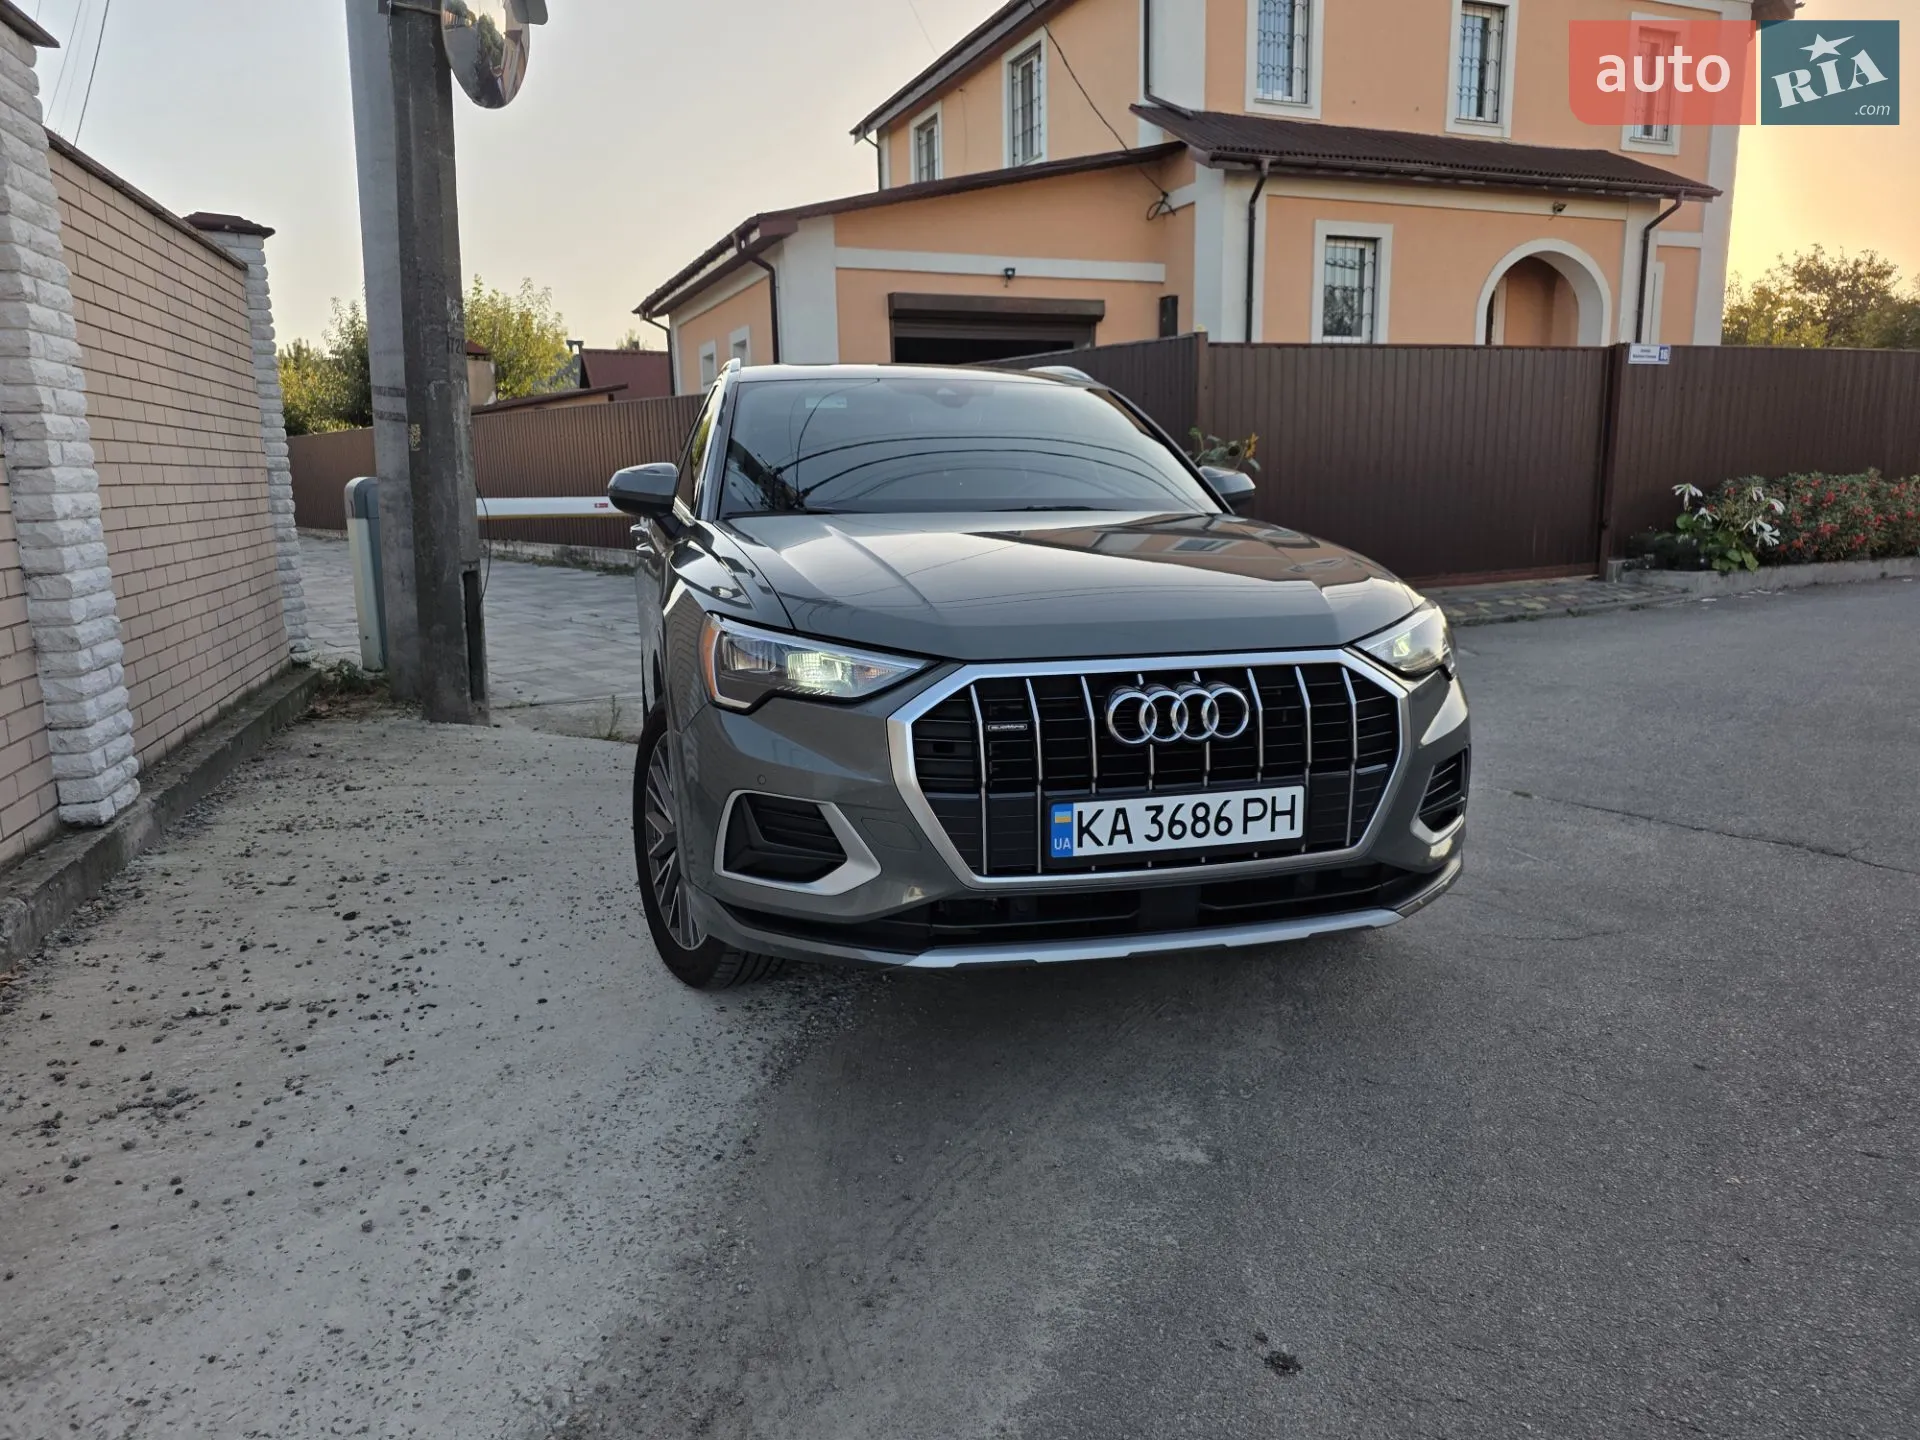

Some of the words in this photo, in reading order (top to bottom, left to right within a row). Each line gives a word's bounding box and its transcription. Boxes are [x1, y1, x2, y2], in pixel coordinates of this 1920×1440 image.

[1076, 807, 1134, 848] KA
[1144, 800, 1233, 842] 3686
[1242, 794, 1297, 835] PH
[1054, 837, 1072, 850] UA
